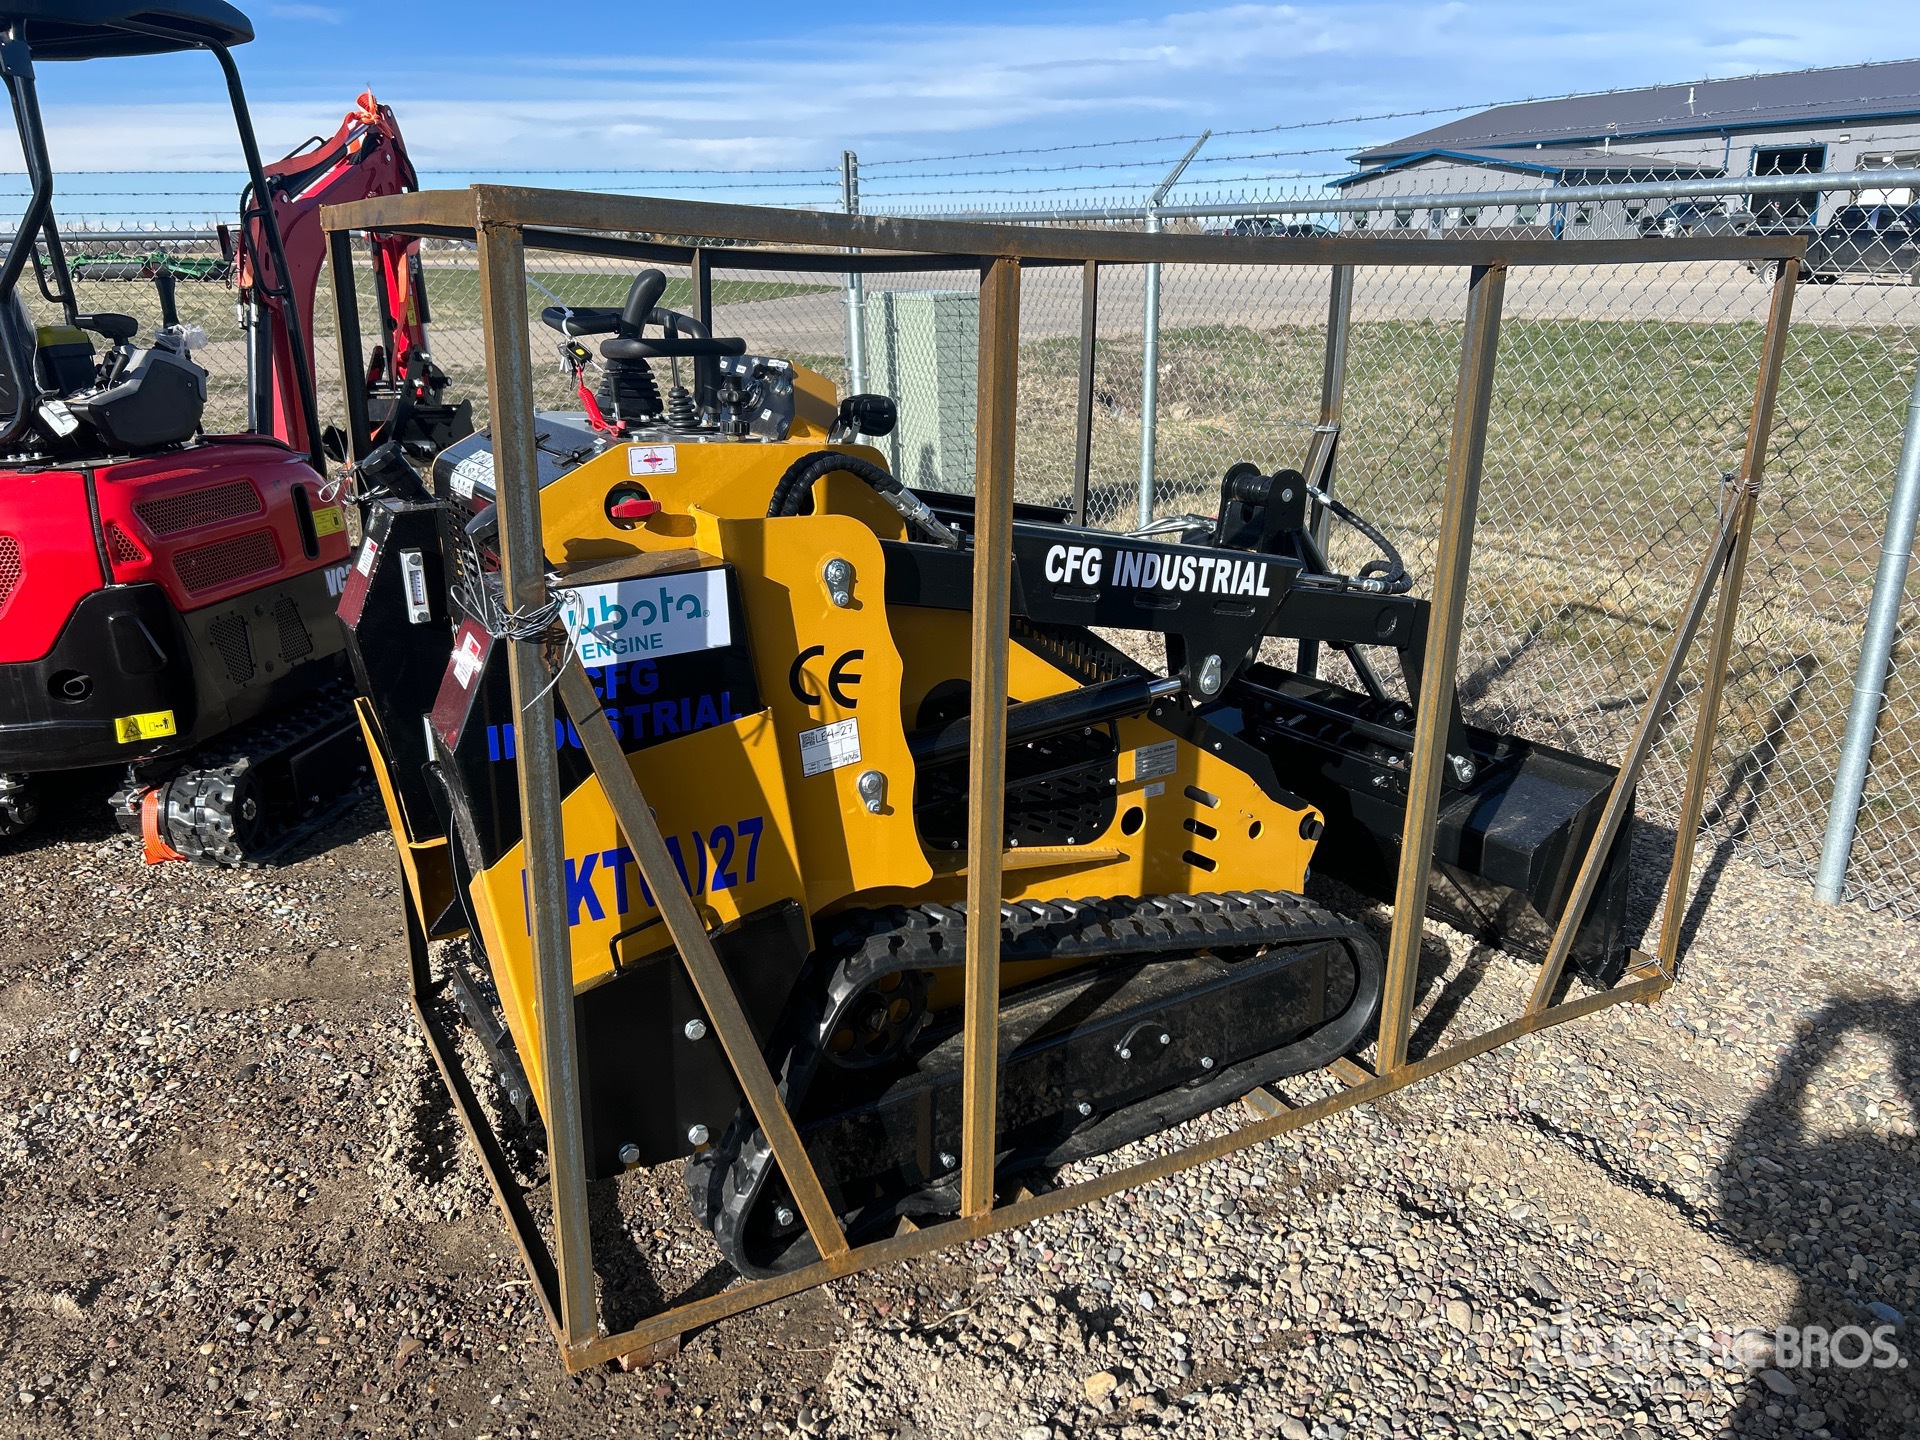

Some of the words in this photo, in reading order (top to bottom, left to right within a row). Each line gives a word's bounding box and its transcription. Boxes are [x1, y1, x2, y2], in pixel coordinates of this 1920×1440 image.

[1044, 544, 1103, 586] CFG
[1111, 550, 1271, 597] INDUSTRIAL
[566, 587, 702, 635] ubota
[582, 632, 664, 660] ENGINE
[788, 645, 865, 709] CE
[521, 816, 763, 937] KT(A)27
